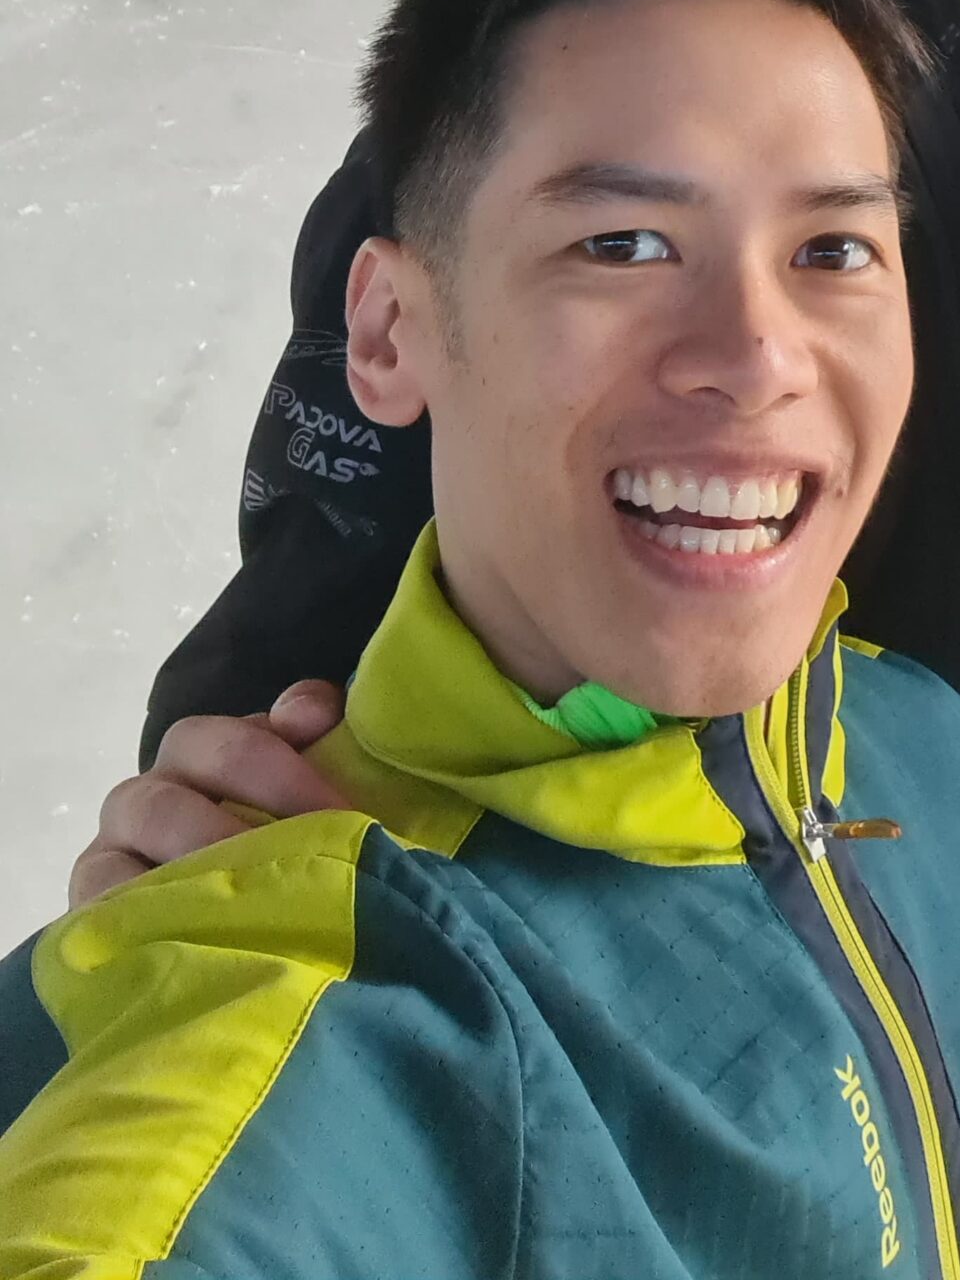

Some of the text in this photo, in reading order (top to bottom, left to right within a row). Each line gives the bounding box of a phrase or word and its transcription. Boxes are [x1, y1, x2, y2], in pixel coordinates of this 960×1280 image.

[264, 381, 383, 453] PADOVA
[287, 428, 361, 484] GAS
[833, 1053, 900, 1269] Reebok
